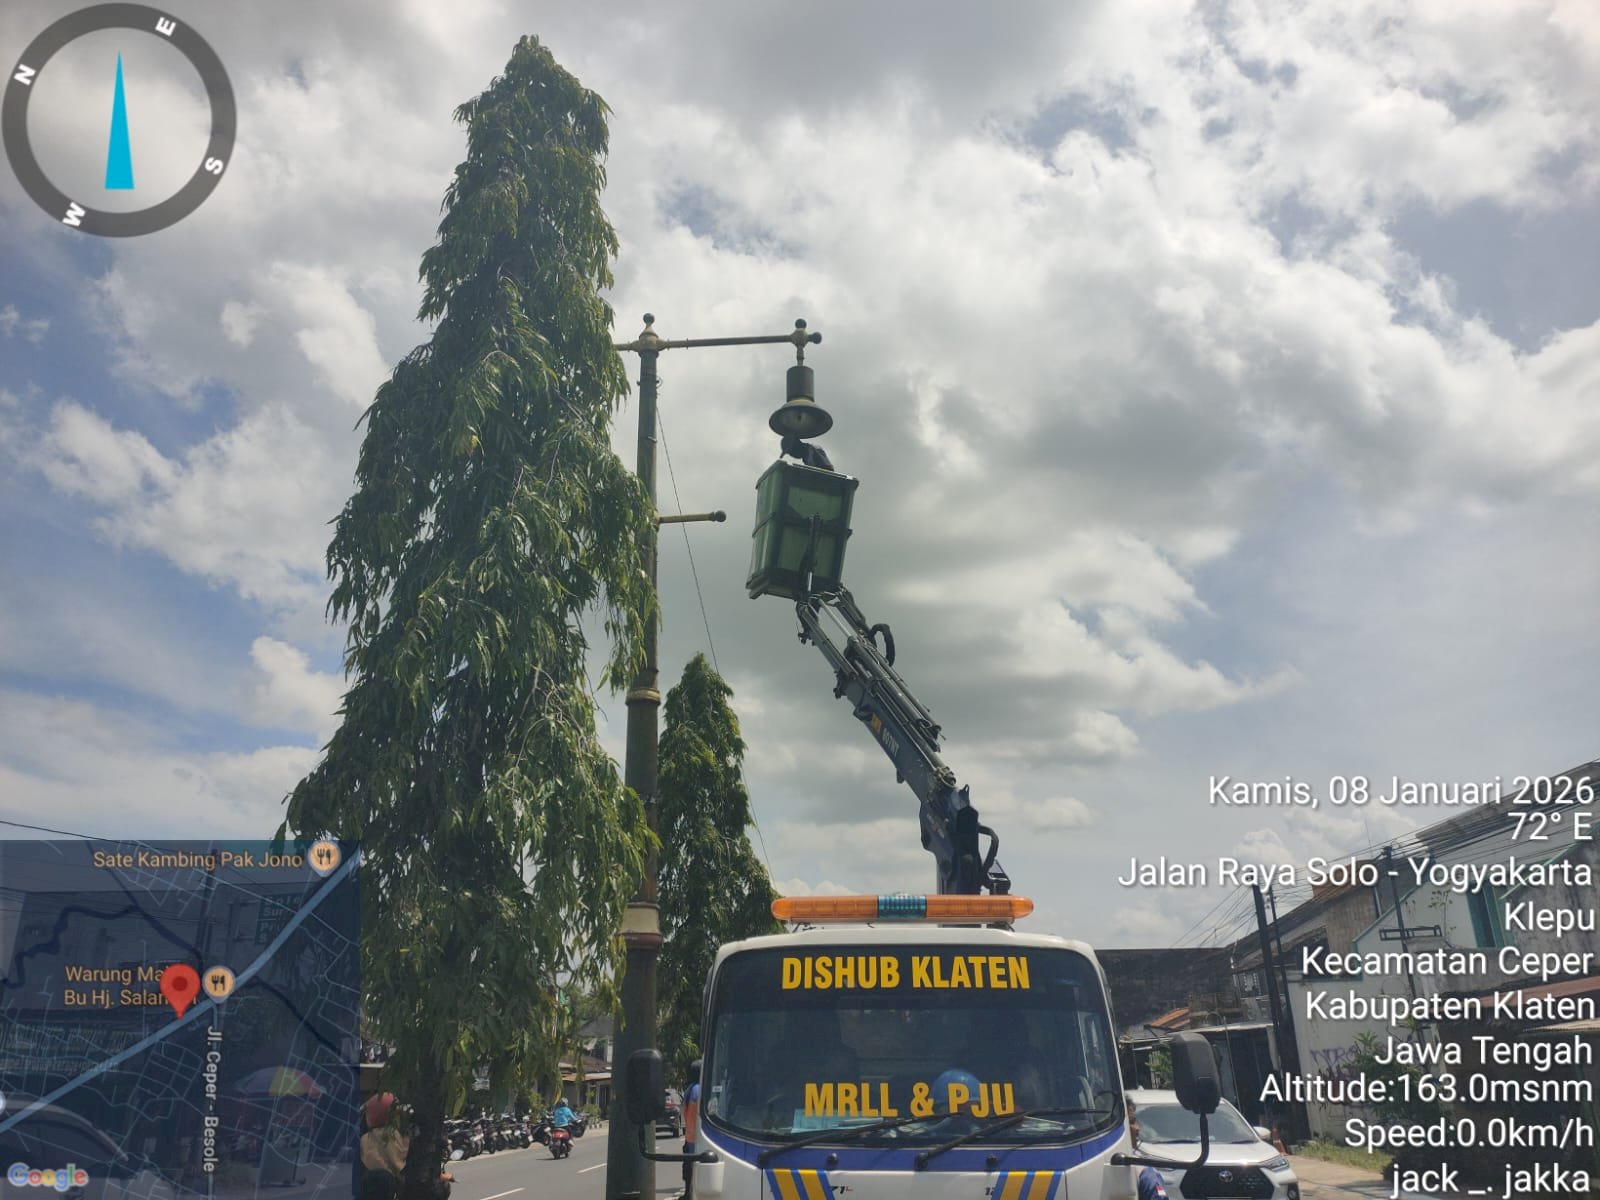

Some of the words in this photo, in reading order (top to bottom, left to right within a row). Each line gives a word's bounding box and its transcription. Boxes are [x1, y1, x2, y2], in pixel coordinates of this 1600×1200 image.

[782, 956, 899, 989] DISHUB
[911, 956, 1030, 989] KLATEN
[805, 1082, 898, 1118] MRLL
[910, 1082, 934, 1118] &
[948, 1082, 1016, 1119] PJU
